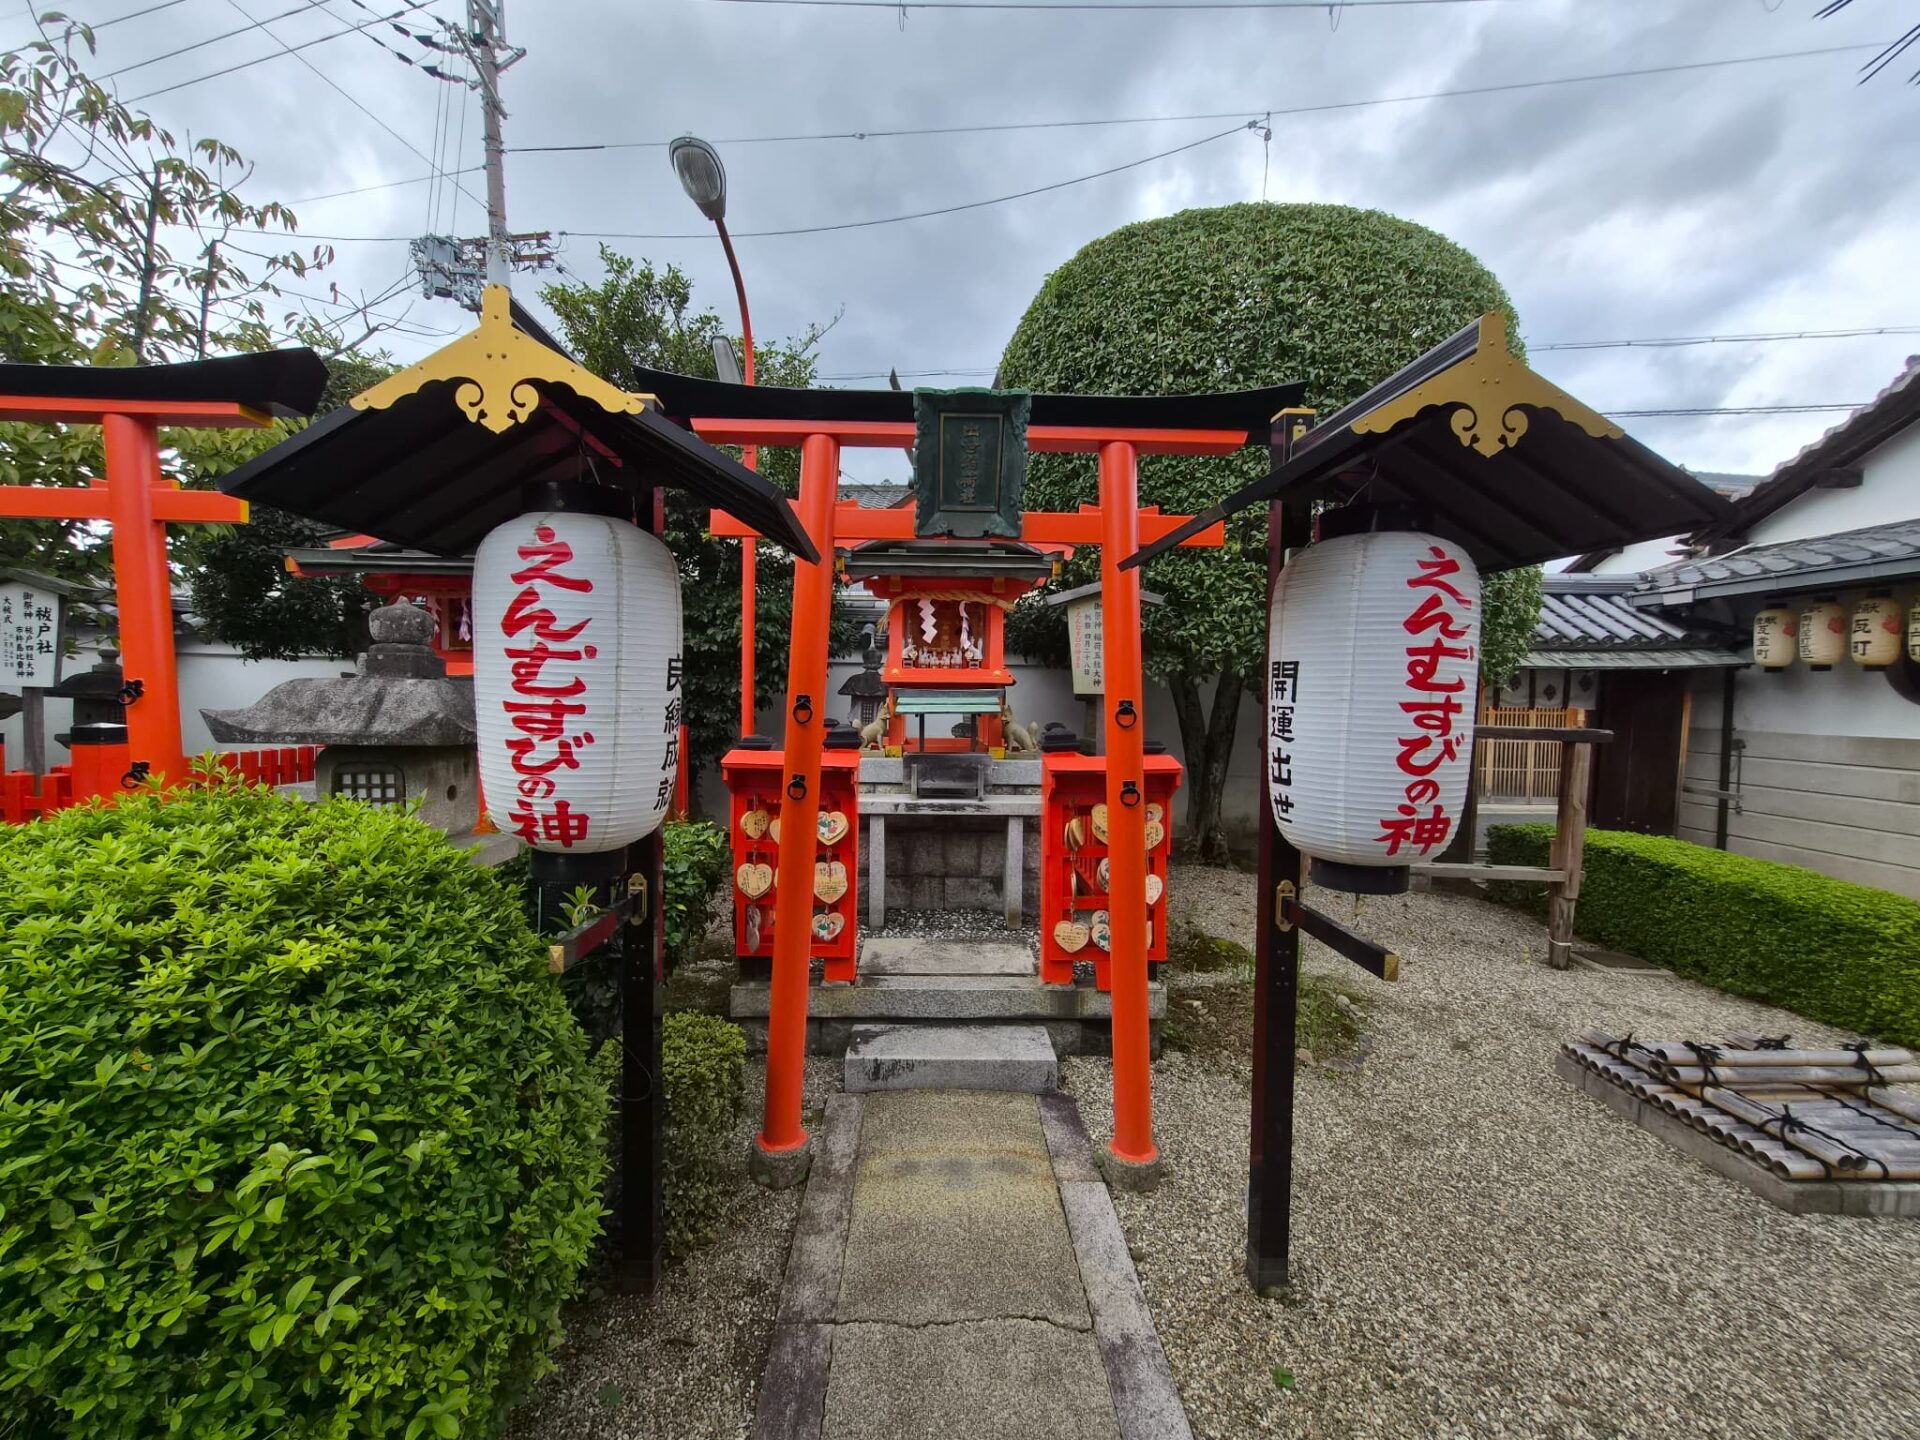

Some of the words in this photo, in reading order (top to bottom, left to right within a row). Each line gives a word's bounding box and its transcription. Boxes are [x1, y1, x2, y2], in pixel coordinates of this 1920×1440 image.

[35, 606, 54, 654] 祓戸社
[500, 526, 598, 849] えんむすびの神
[1270, 660, 1300, 823] 開運出世
[1372, 546, 1474, 857] えんむすびの神
